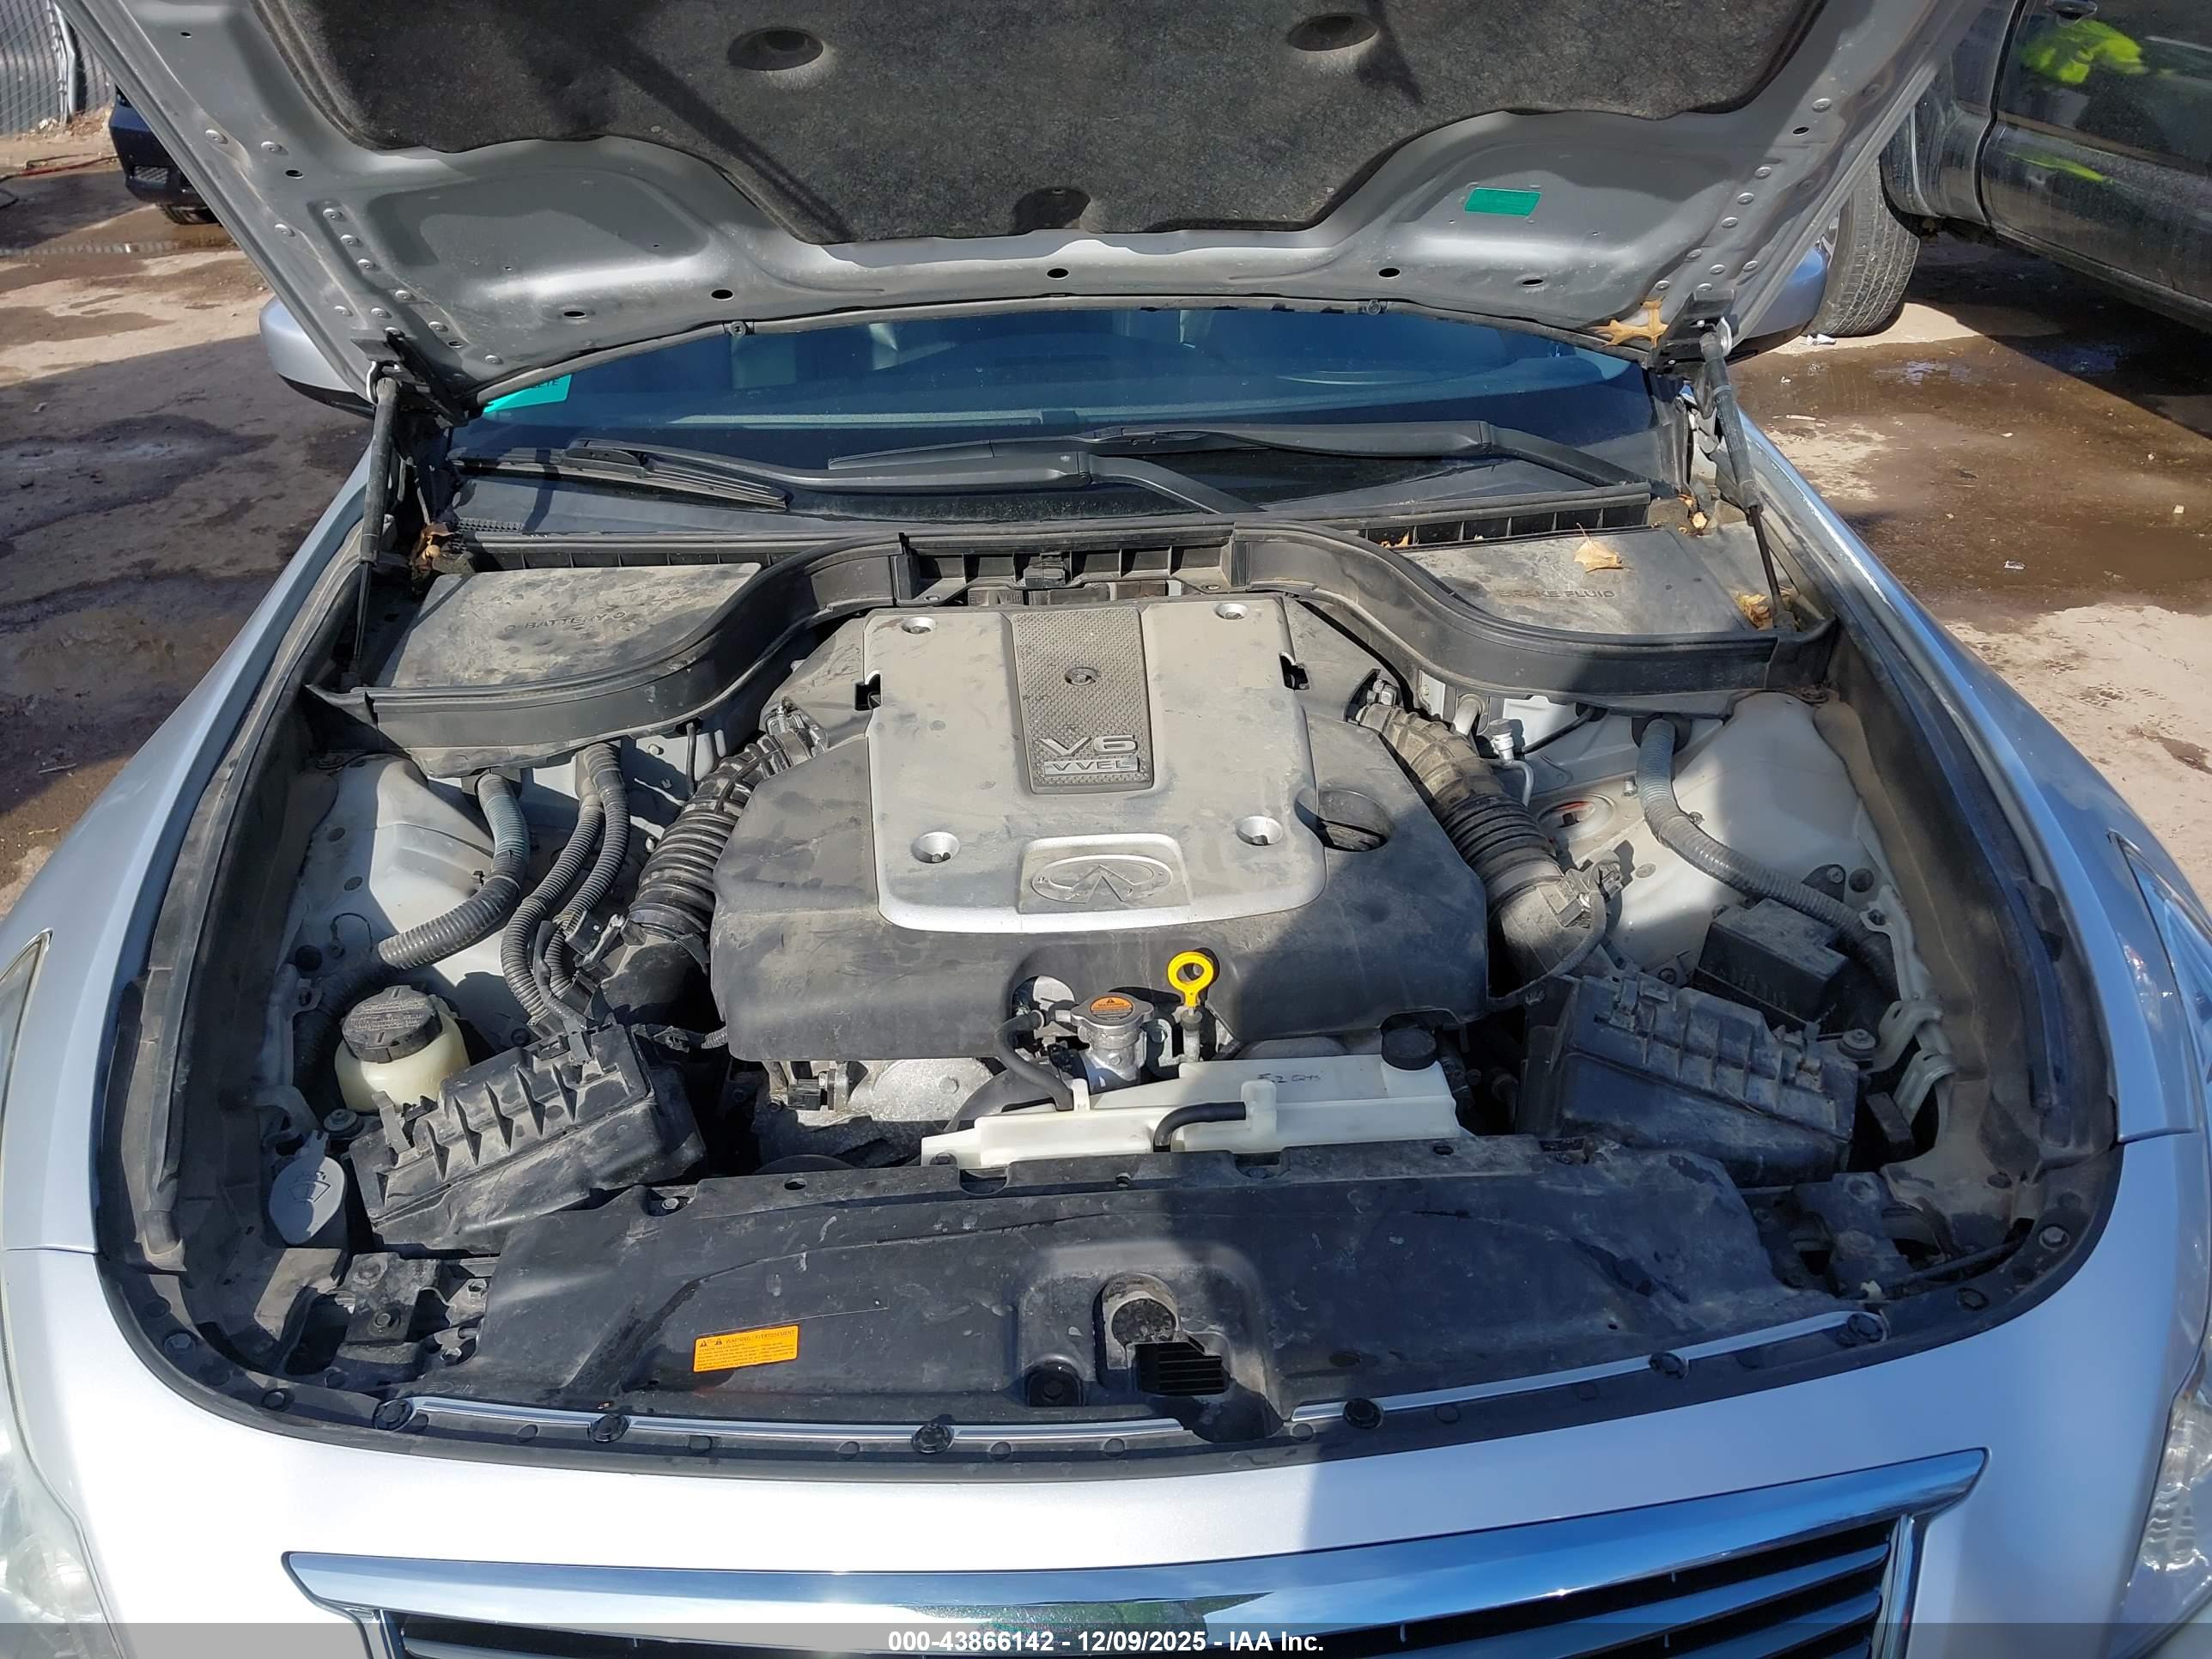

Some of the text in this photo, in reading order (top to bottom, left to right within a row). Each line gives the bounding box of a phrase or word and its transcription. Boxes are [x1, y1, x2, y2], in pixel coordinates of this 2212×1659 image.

[1498, 589, 1615, 599] BRAKE FLUID
[525, 613, 607, 629] BATTERY
[1038, 735, 1138, 757] V6
[1053, 760, 1122, 771] VVEL
